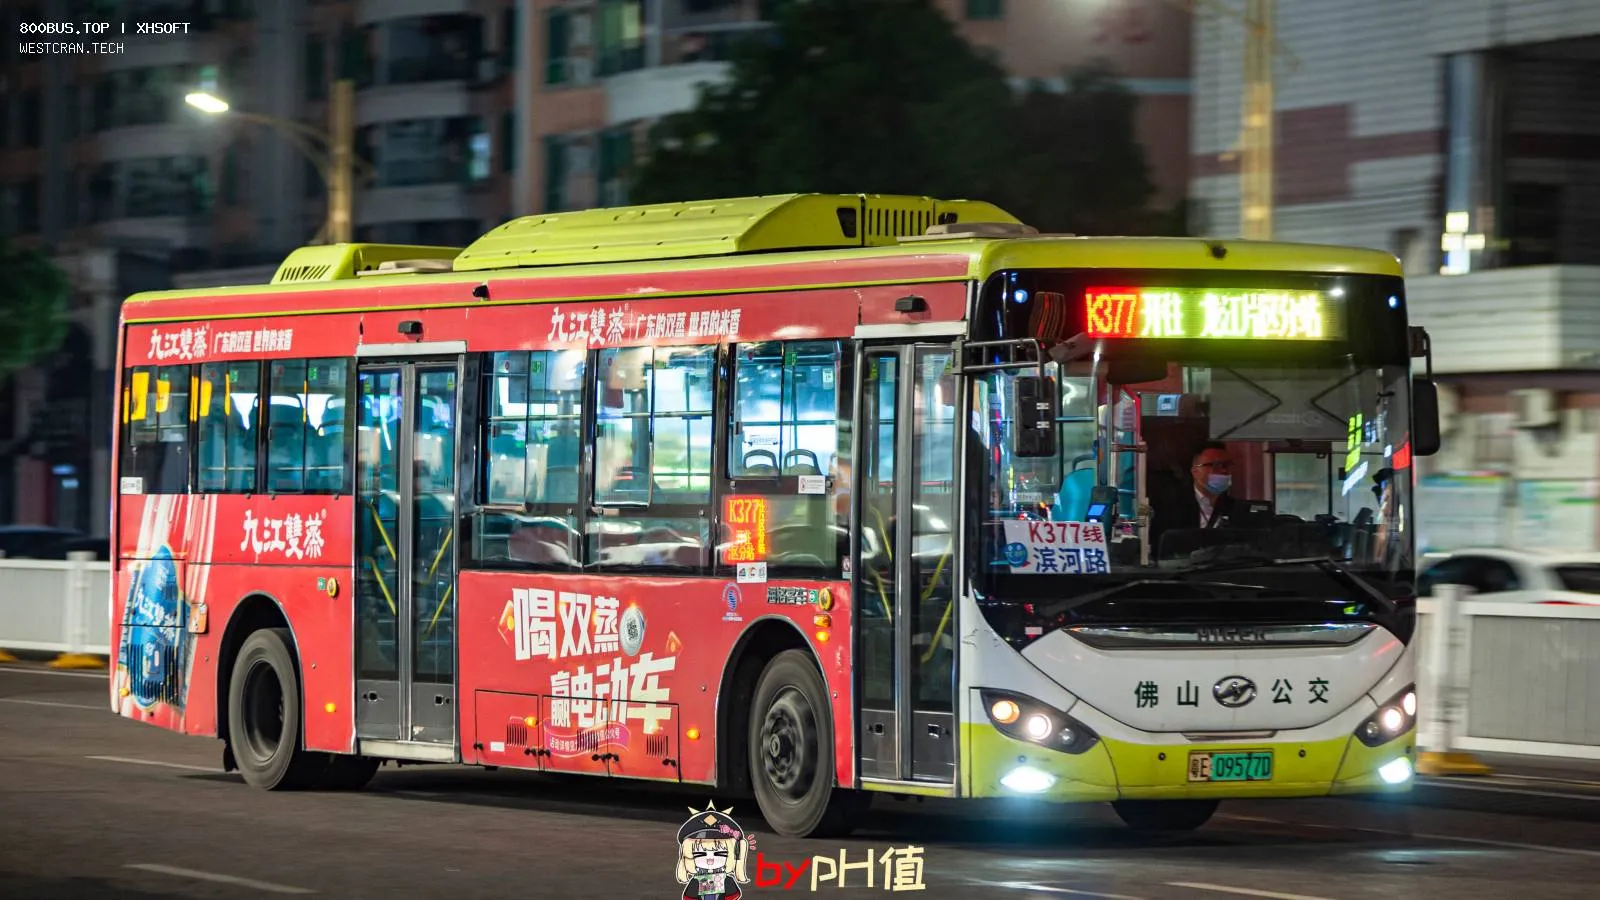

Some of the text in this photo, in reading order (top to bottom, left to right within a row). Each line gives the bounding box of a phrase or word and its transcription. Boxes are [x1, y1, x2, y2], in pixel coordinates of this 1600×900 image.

[1086, 293, 1137, 334] K377
[729, 498, 760, 523] K377
[1028, 521, 1104, 544] K377线
[1033, 547, 1107, 574] 滨河路
[512, 587, 620, 661] 喝双蒸
[550, 651, 677, 735] 赢电动车
[1134, 676, 1330, 708] 佛山 公交
